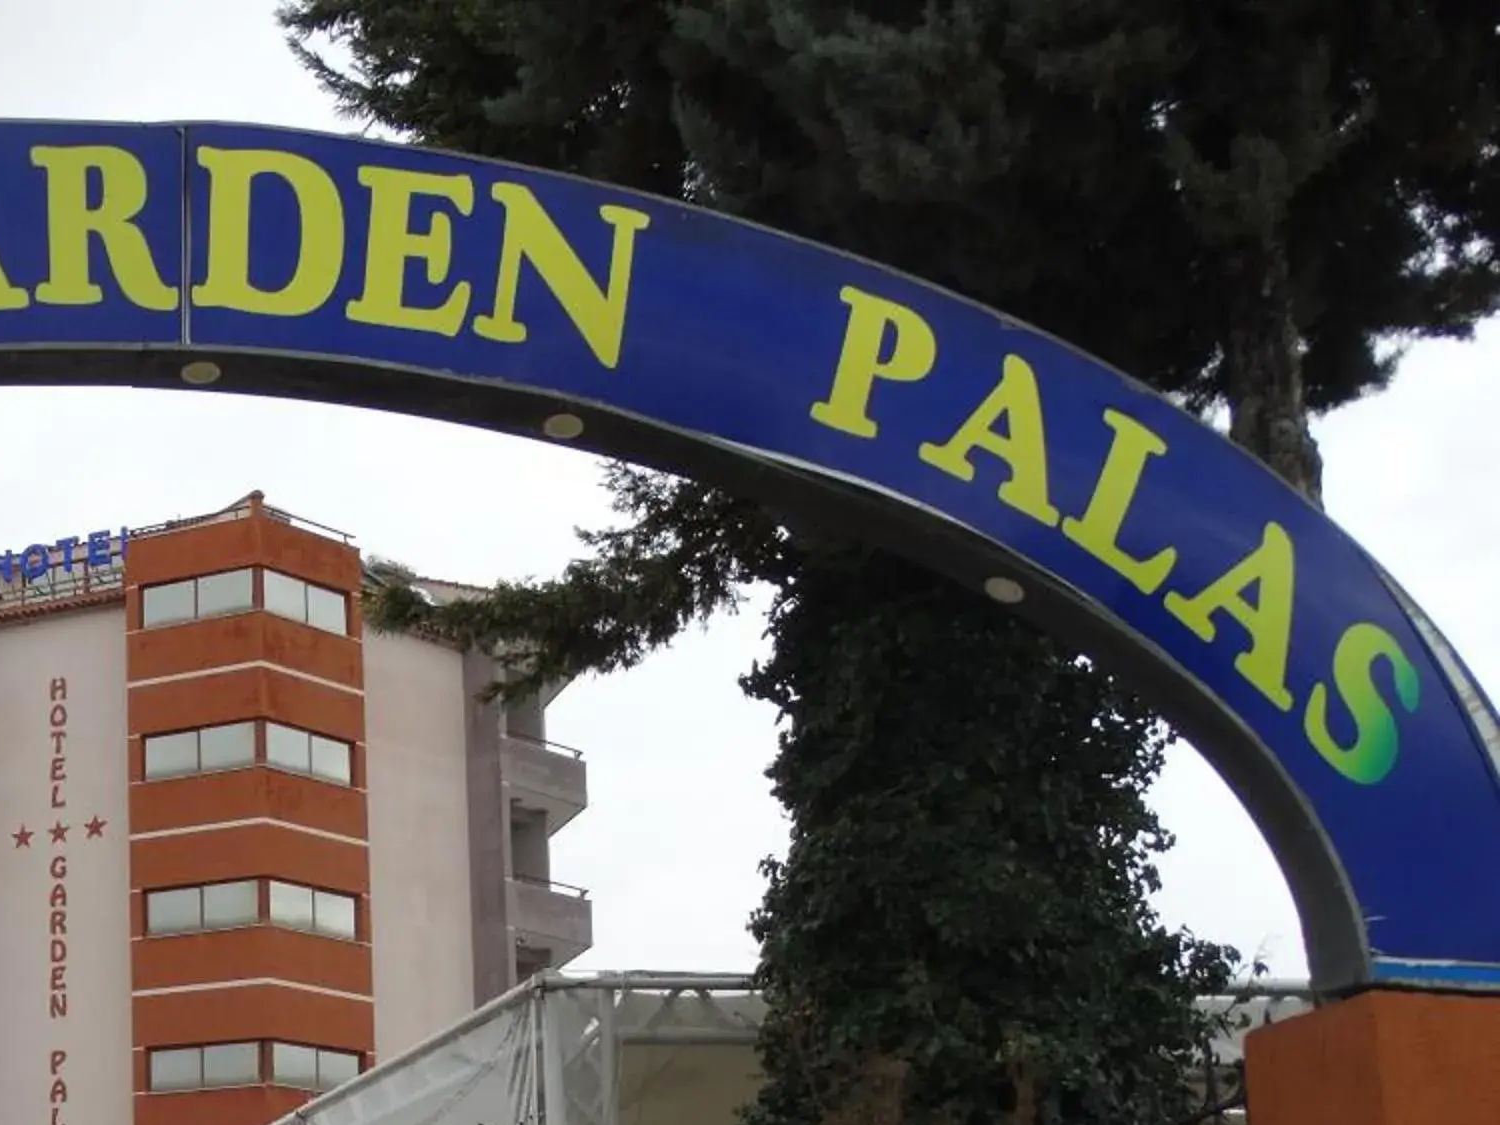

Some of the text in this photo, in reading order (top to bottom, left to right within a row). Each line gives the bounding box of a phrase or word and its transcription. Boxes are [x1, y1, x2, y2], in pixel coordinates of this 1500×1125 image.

[810, 285, 1420, 786] PALAS
[49, 676, 68, 809] HOTEL
[49, 856, 68, 1018] GARDEN
